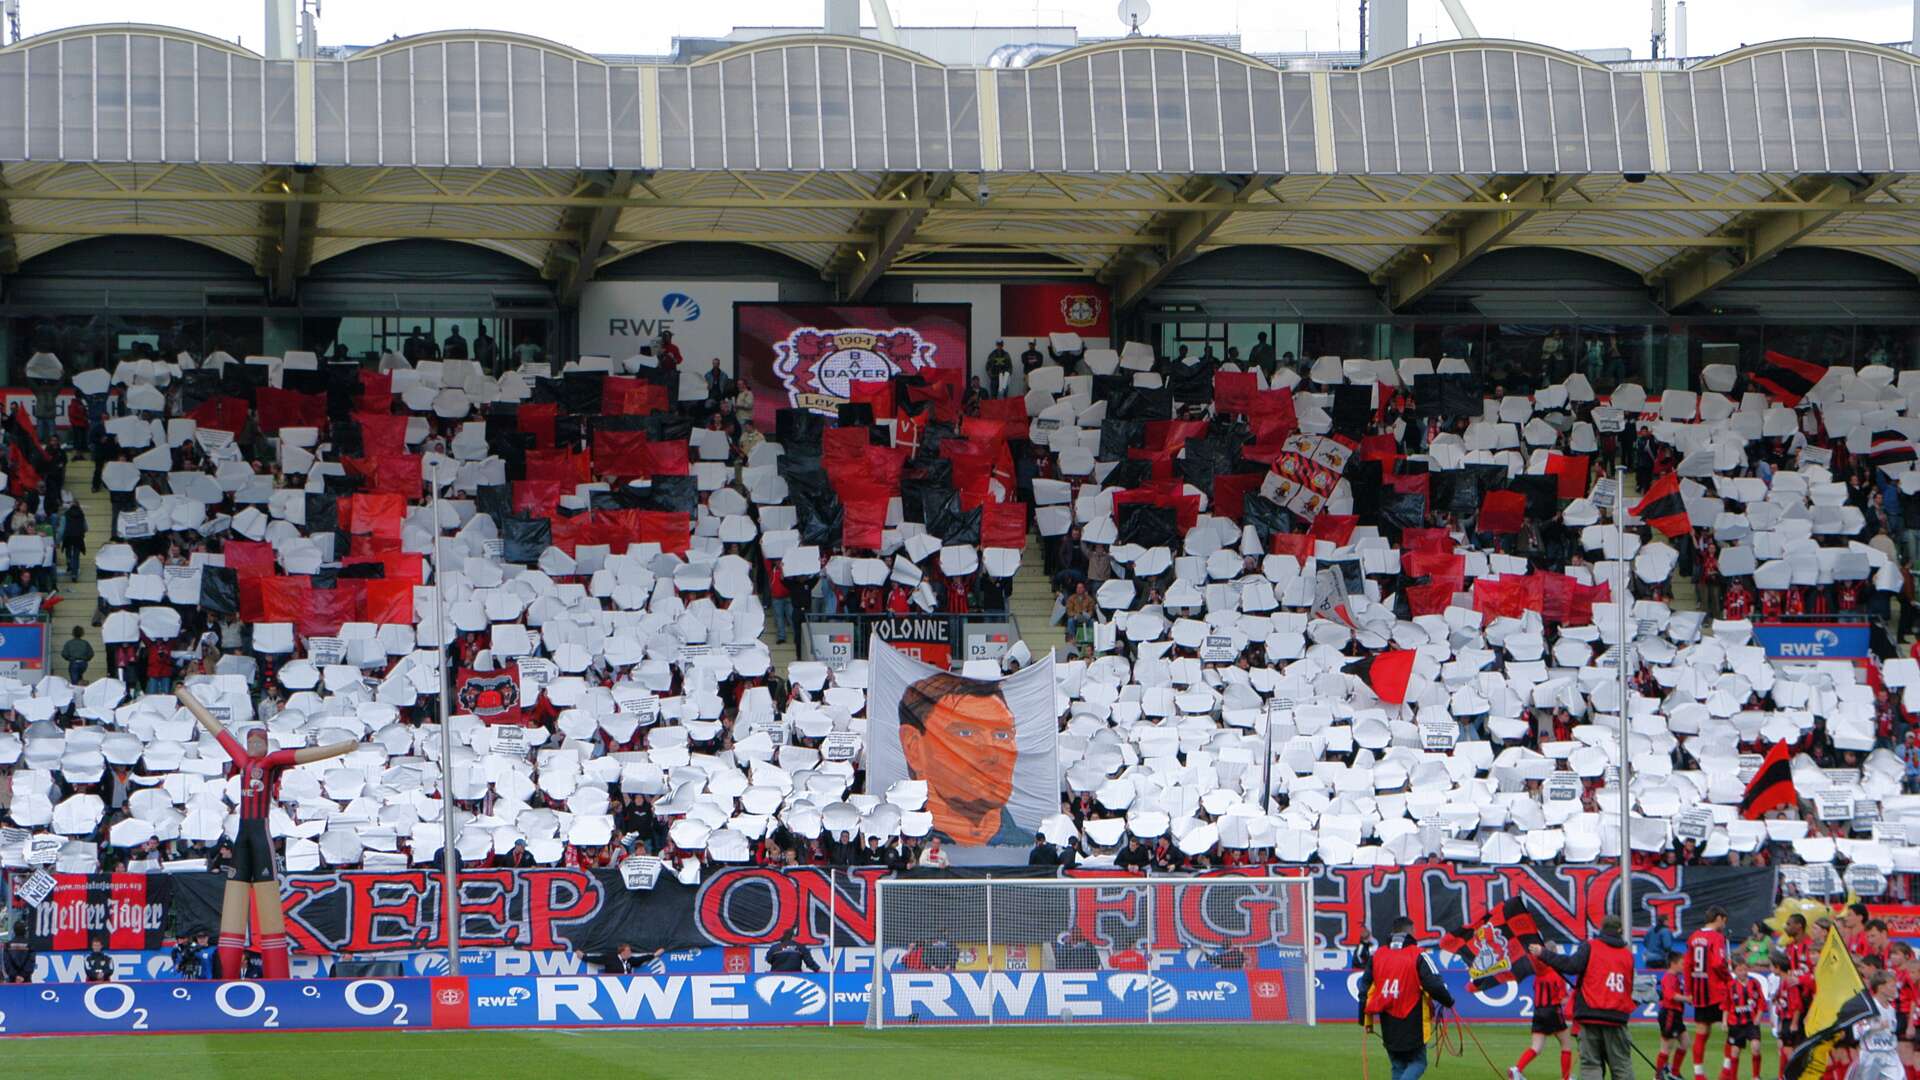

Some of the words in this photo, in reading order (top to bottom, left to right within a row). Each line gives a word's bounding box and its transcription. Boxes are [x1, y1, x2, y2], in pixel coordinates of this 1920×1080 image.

[609, 319, 674, 336] RWE
[838, 336, 871, 348] 1904
[824, 368, 886, 379] BAYER
[833, 645, 847, 654] D3
[972, 645, 986, 654] D3
[1780, 643, 1824, 656] RWE
[247, 868, 603, 957] KEEP
[695, 865, 895, 948] ON
[1058, 864, 1691, 951] FIGHTING
[460, 955, 484, 964] RWE
[670, 953, 694, 961] RWE
[1694, 946, 1704, 972] 9
[1381, 978, 1399, 999] 44
[1606, 972, 1625, 993] 48
[536, 976, 749, 1021] RWE
[834, 992, 872, 1003] RWE
[891, 973, 1103, 1017] RWE
[1186, 990, 1225, 1001] RWE
[478, 996, 518, 1007] RWE
